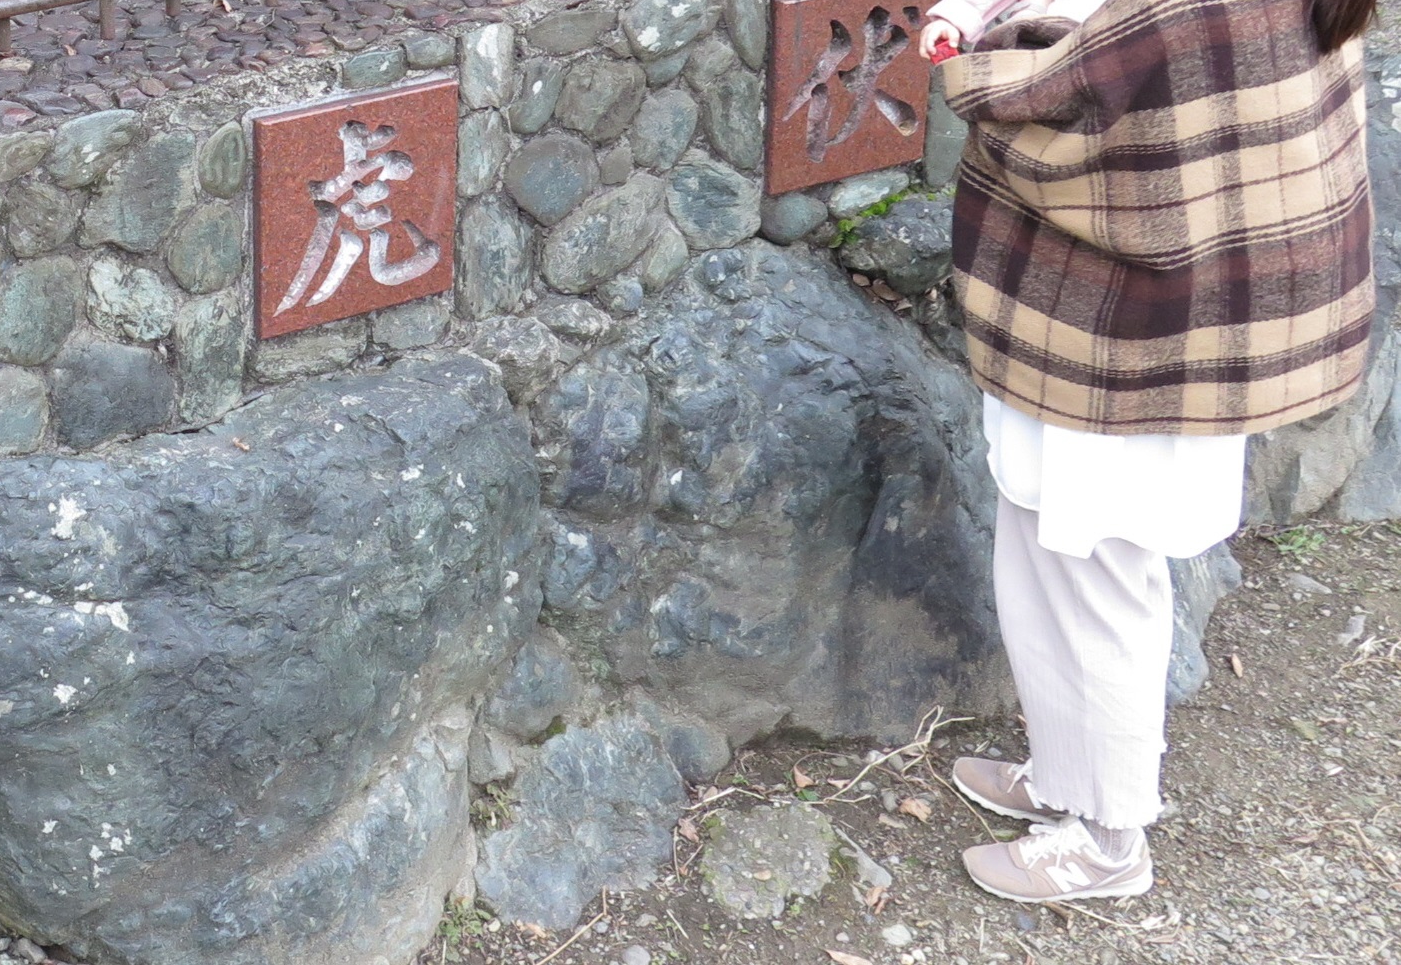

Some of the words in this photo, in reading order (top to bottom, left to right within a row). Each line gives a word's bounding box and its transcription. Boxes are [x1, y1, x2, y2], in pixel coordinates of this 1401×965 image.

[782, 6, 920, 163] 伏
[273, 120, 440, 317] 虎
[1045, 862, 1091, 893] N
